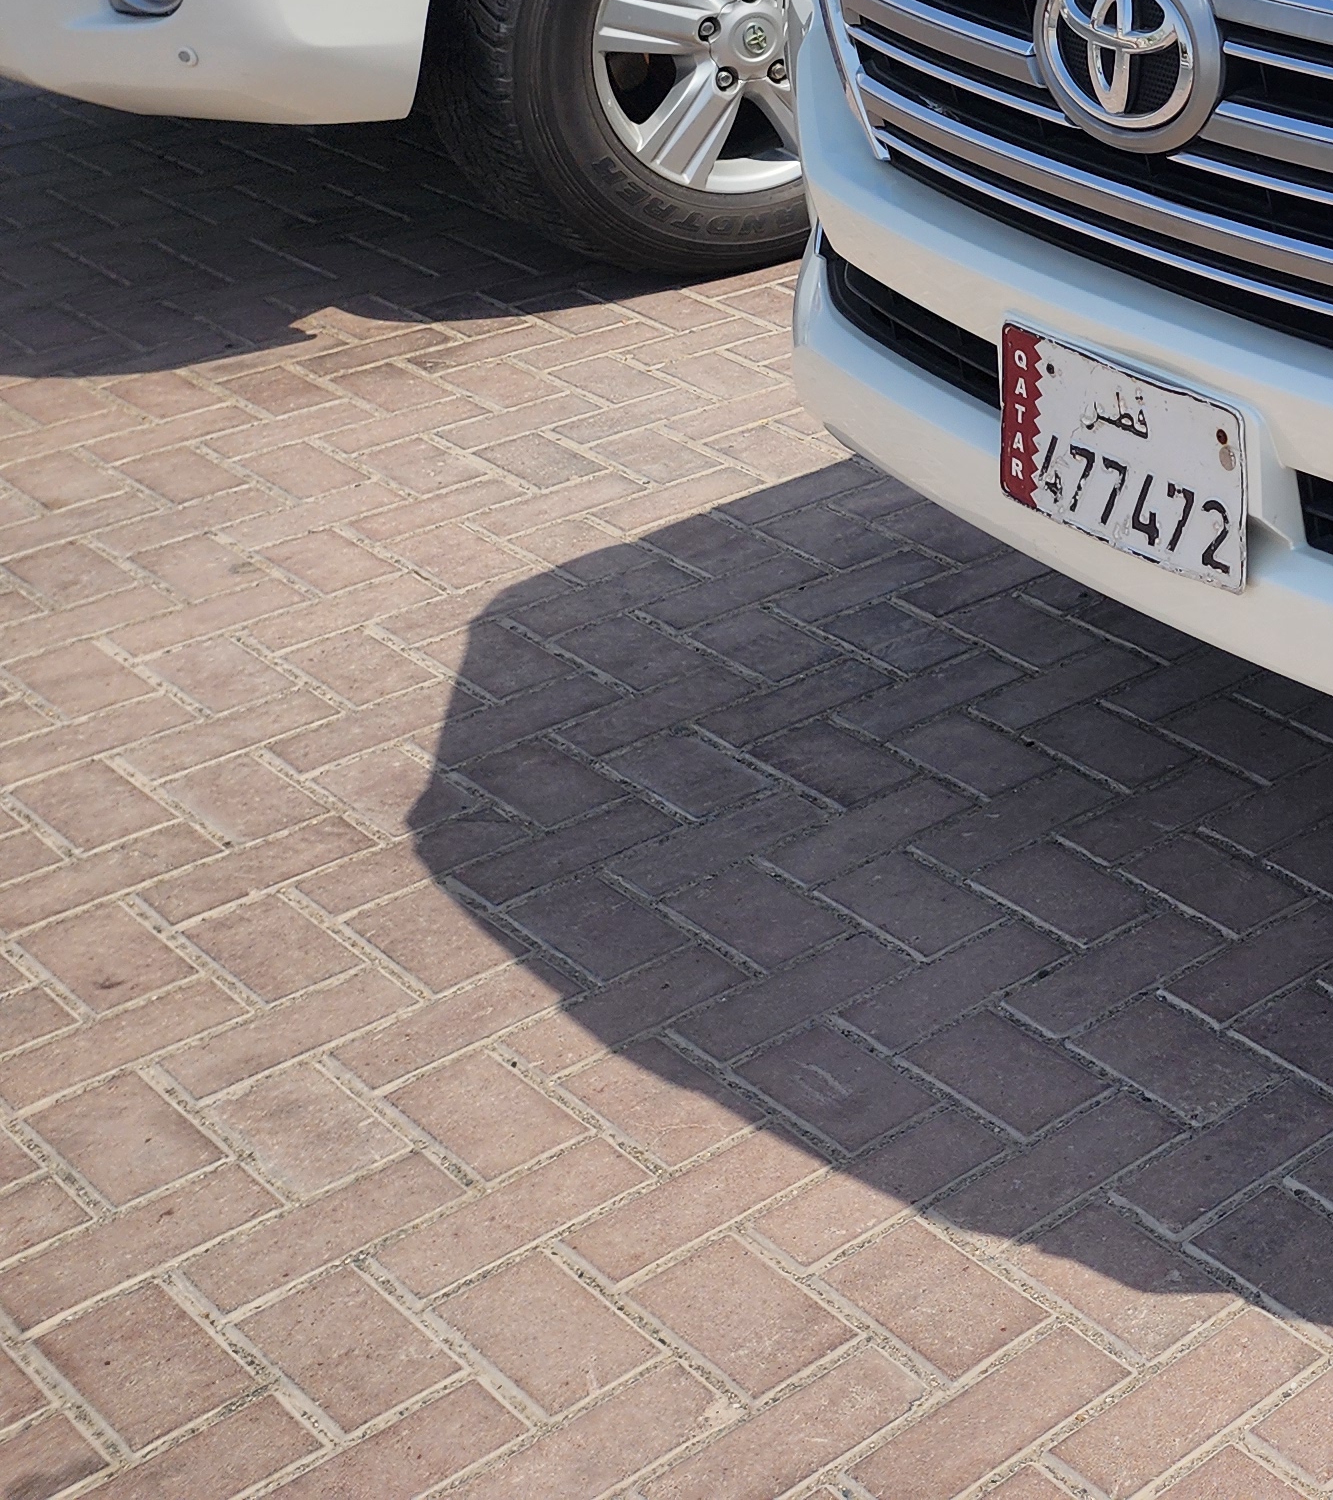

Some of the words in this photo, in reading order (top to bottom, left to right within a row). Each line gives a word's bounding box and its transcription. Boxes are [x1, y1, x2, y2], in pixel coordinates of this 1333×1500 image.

[1010, 349, 1030, 481] QATAR
[1080, 388, 1149, 440] قطر
[1038, 434, 1231, 576] 477472
